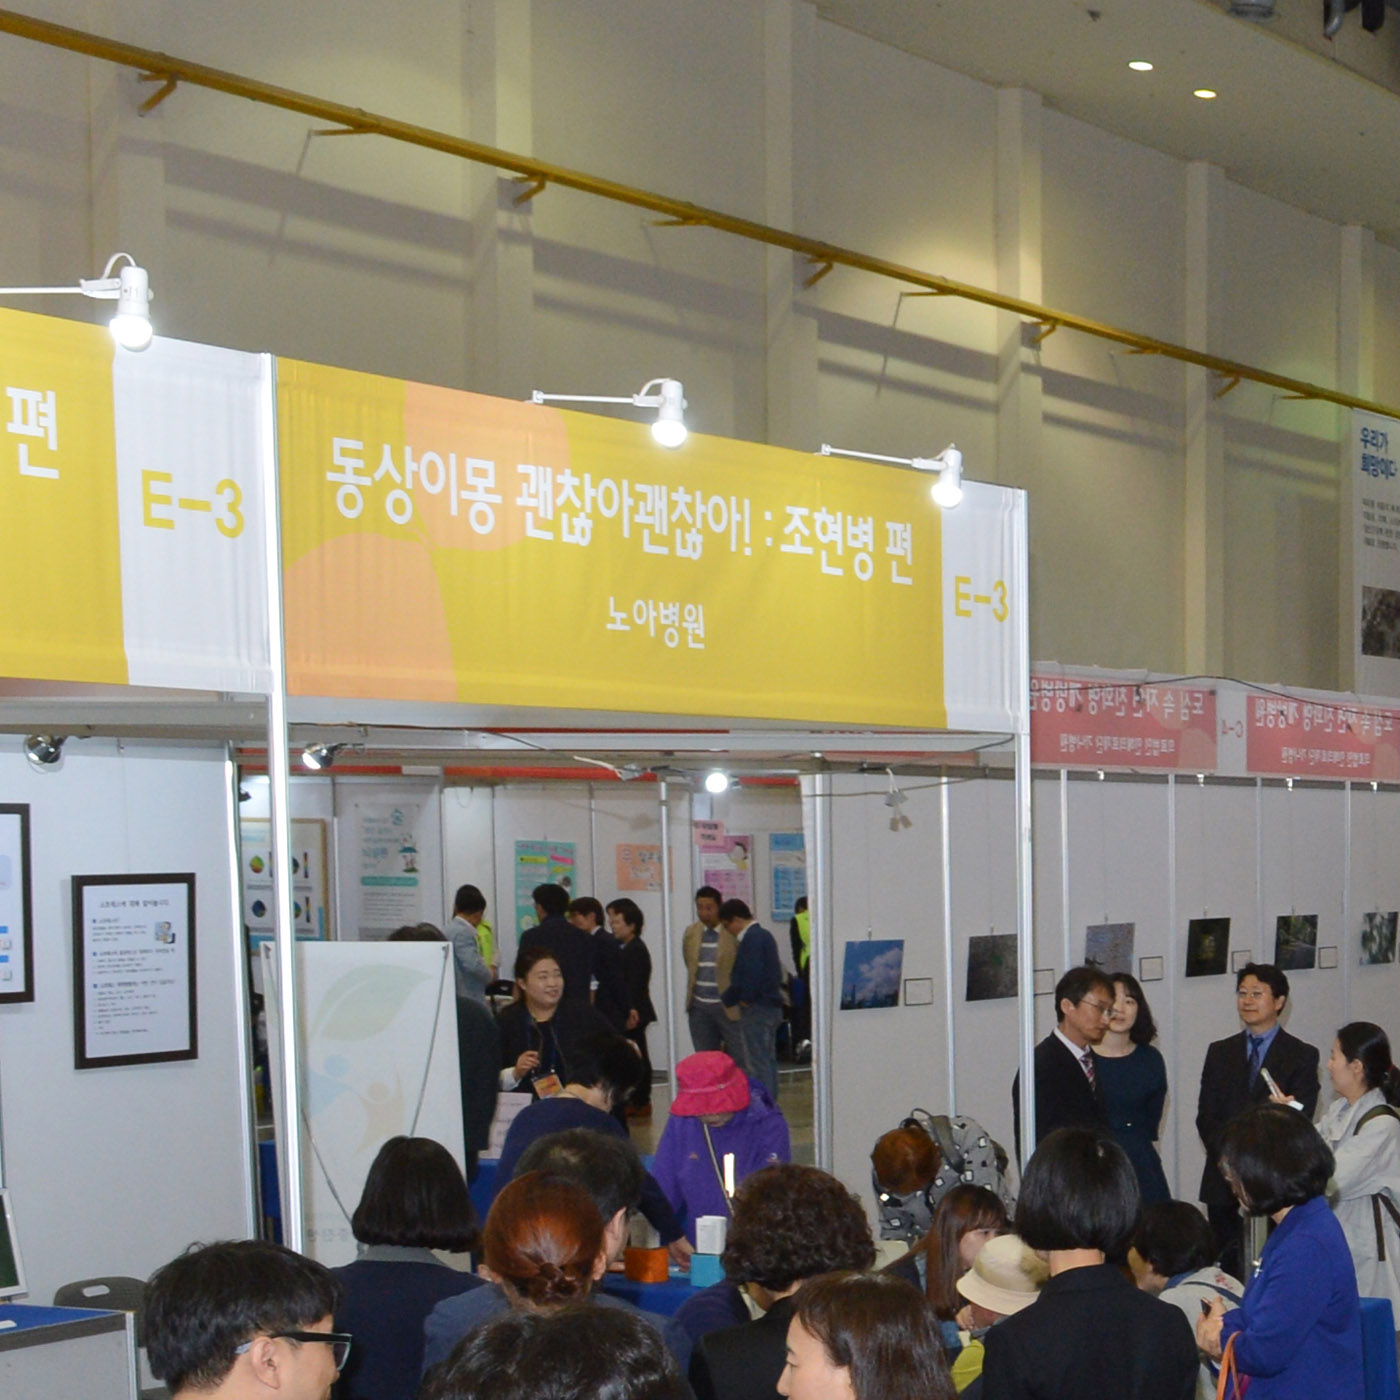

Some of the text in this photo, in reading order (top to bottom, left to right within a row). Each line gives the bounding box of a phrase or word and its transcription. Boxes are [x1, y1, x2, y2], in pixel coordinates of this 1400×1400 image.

[5, 386, 60, 480] 편
[141, 468, 245, 539] E-3
[326, 436, 503, 535] 동상이몽
[516, 464, 753, 561] 괜찮아괜찮아!
[780, 505, 874, 581] 조현병
[885, 521, 913, 585] 편
[606, 596, 705, 649] 노아병원
[955, 576, 1009, 622] E-3
